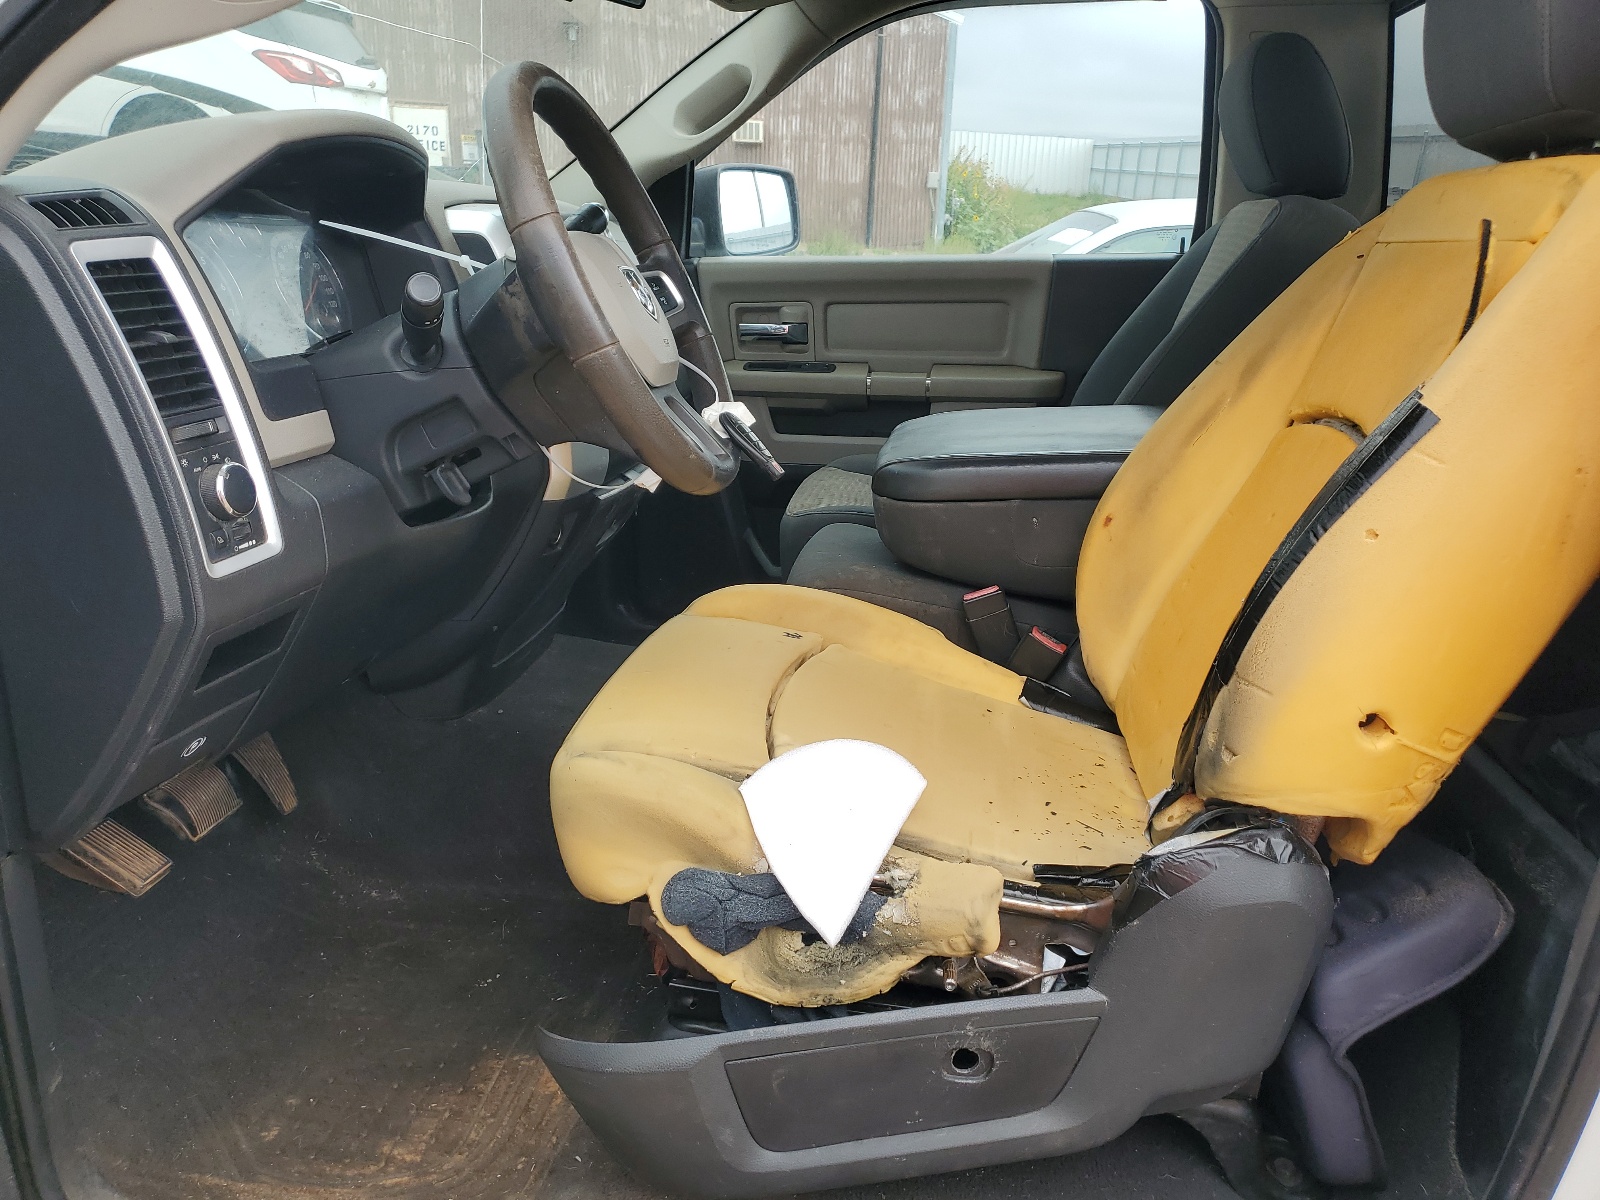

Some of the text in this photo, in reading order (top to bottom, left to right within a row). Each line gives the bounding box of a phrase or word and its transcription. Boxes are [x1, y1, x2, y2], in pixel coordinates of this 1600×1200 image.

[406, 124, 439, 136] 2170
[318, 274, 329, 282] 100
[325, 287, 335, 295] 110
[328, 300, 338, 308] 120
